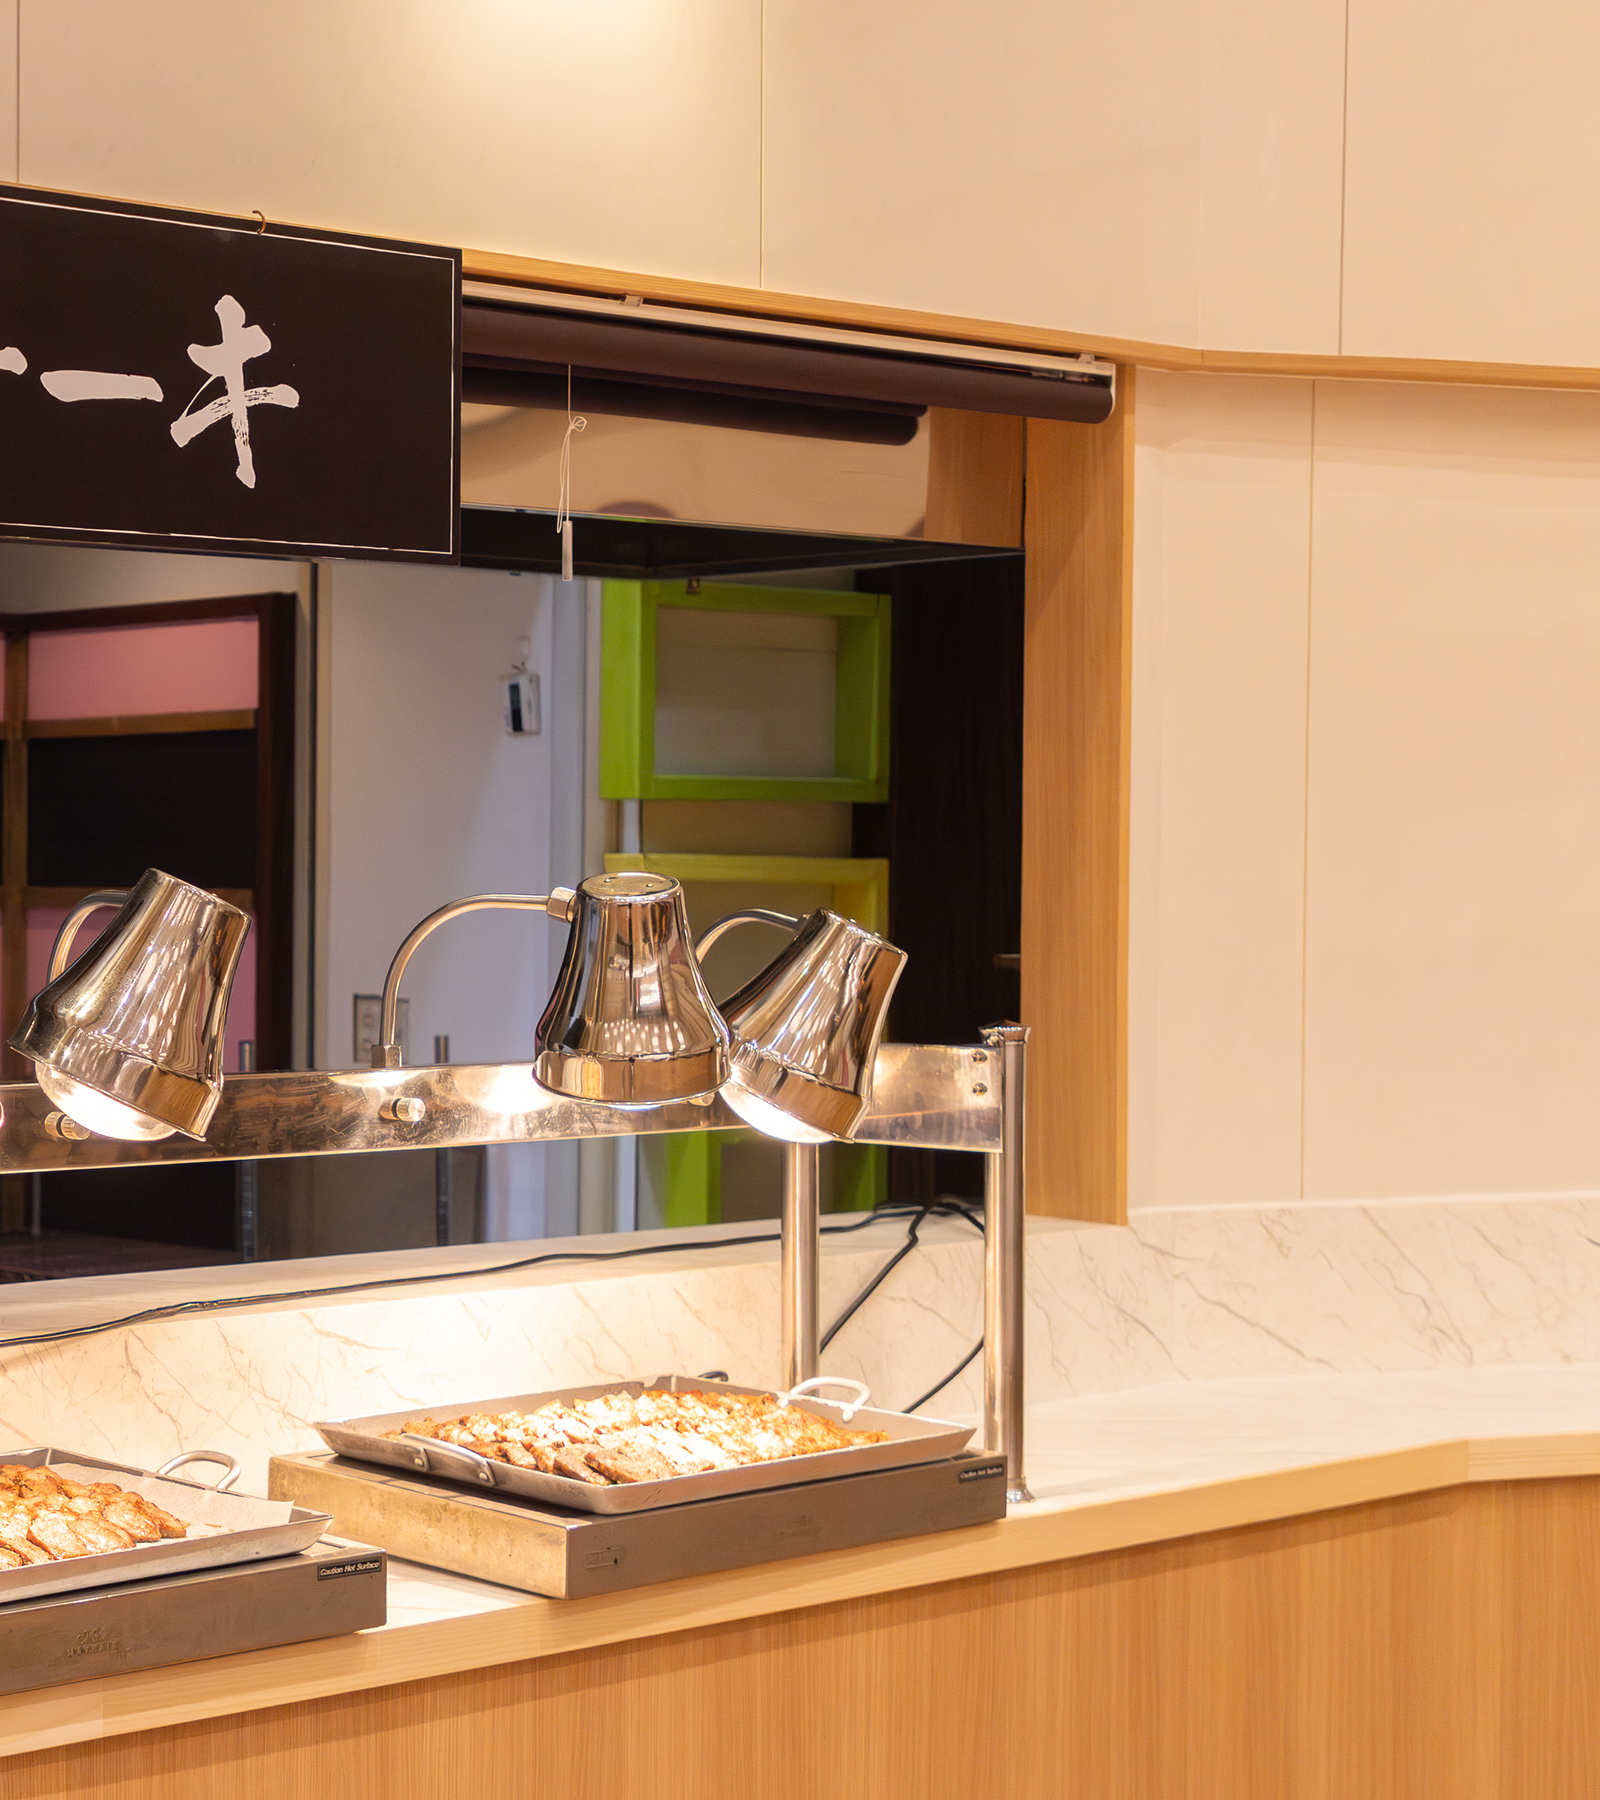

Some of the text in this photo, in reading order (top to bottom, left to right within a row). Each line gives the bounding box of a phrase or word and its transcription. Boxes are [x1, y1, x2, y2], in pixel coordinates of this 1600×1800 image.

[320, 1561, 380, 1576] Caution Hot Surface
